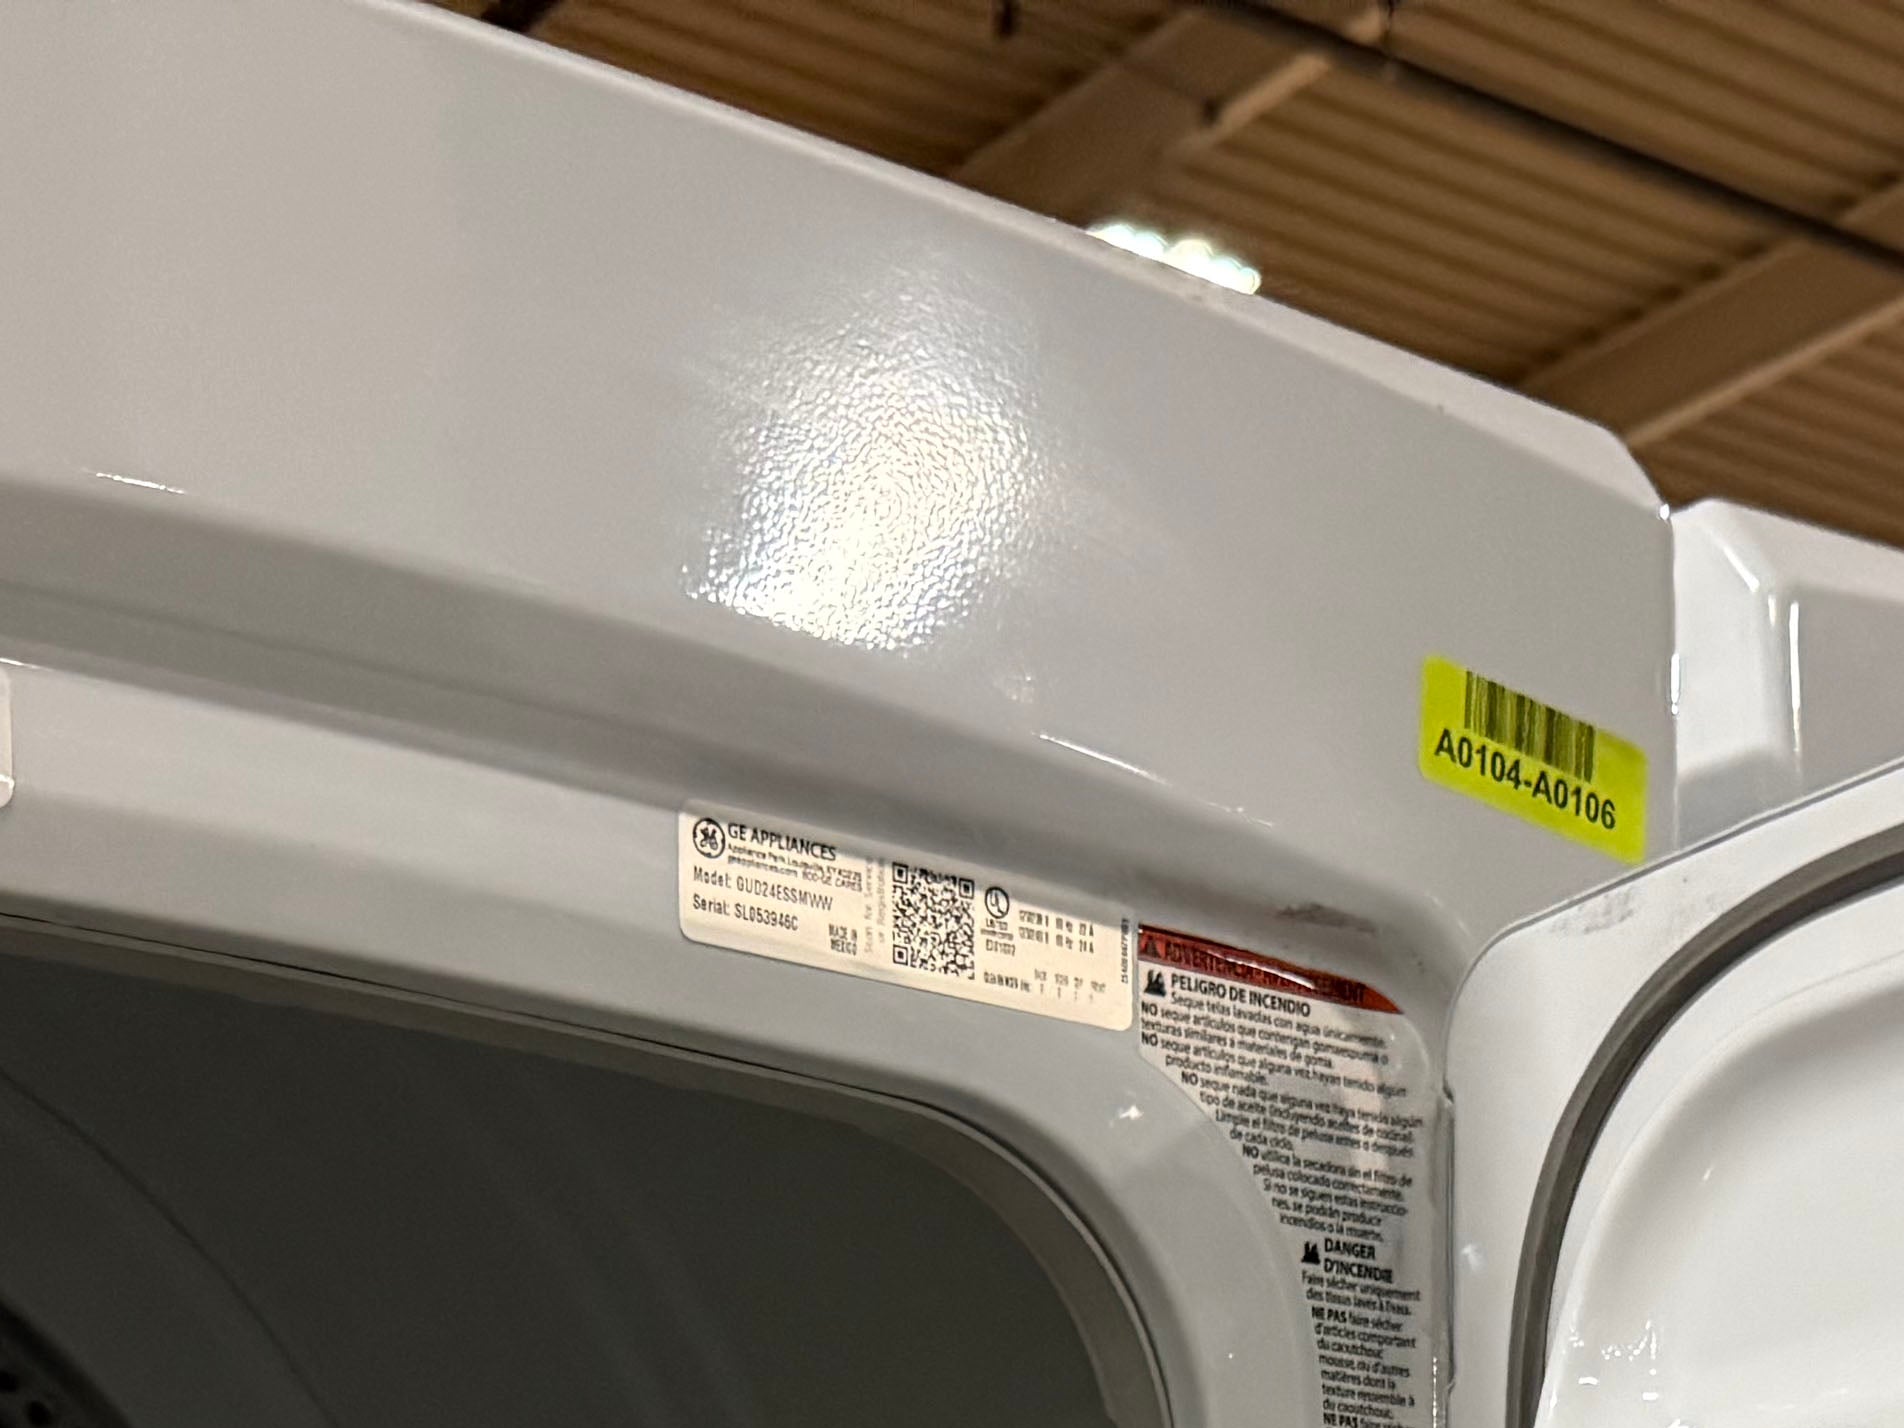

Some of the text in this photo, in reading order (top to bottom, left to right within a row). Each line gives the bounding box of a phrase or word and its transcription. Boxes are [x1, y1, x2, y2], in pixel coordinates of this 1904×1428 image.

[1435, 729, 1615, 829] A0104-A0106
[728, 823, 836, 861] GE APPLIANCES
[694, 866, 731, 888] Model:
[693, 893, 731, 916] Serial:
[1171, 973, 1310, 1016] PELIGRO DE INCENDIO
[1324, 1238, 1376, 1260] DANGER
